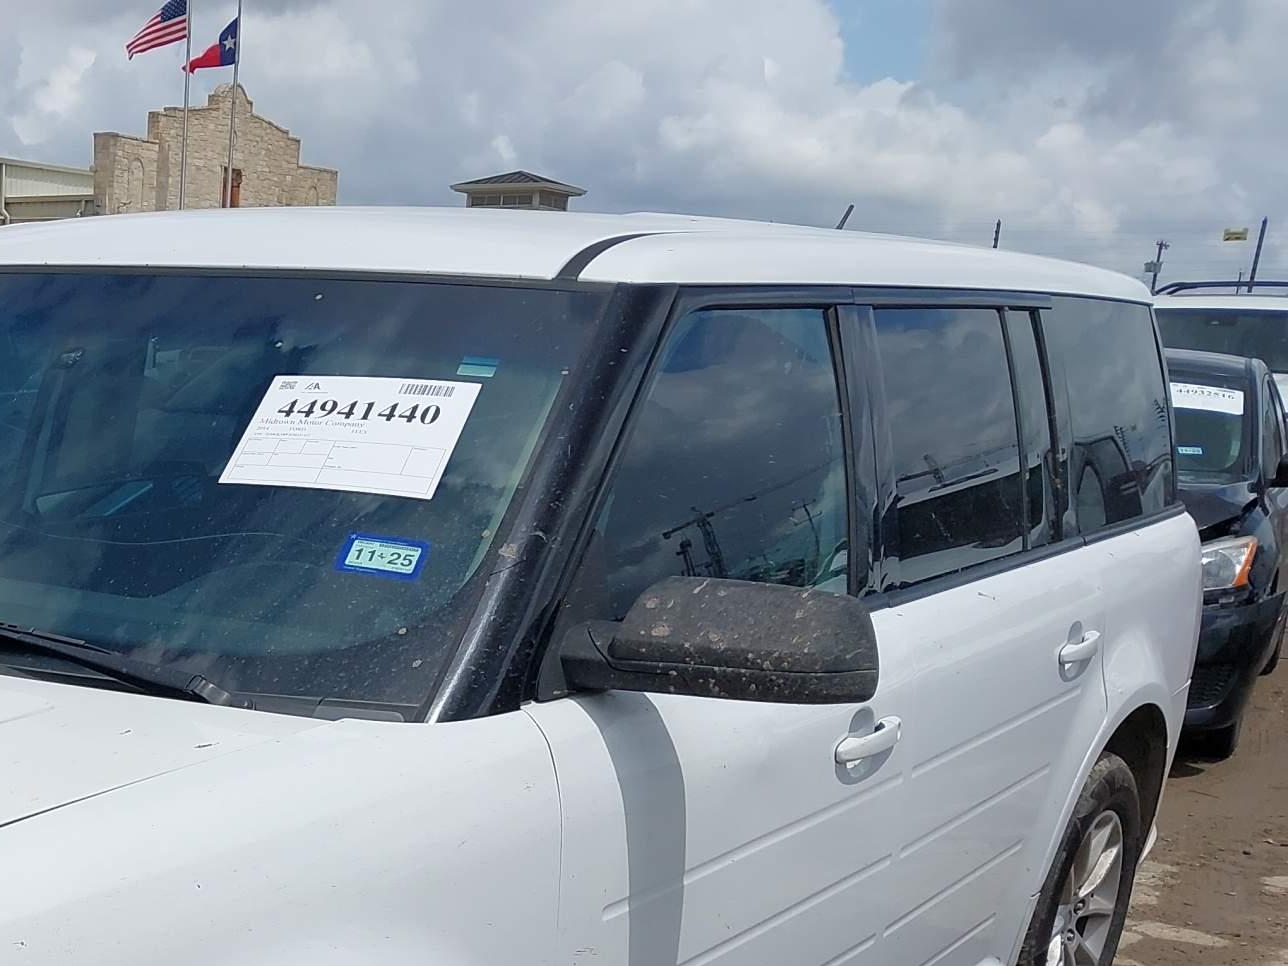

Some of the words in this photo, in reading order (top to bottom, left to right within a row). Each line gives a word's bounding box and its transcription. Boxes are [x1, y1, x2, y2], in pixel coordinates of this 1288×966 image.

[277, 398, 441, 425] 44941440
[355, 547, 377, 562] 11
[387, 551, 416, 567] 25
